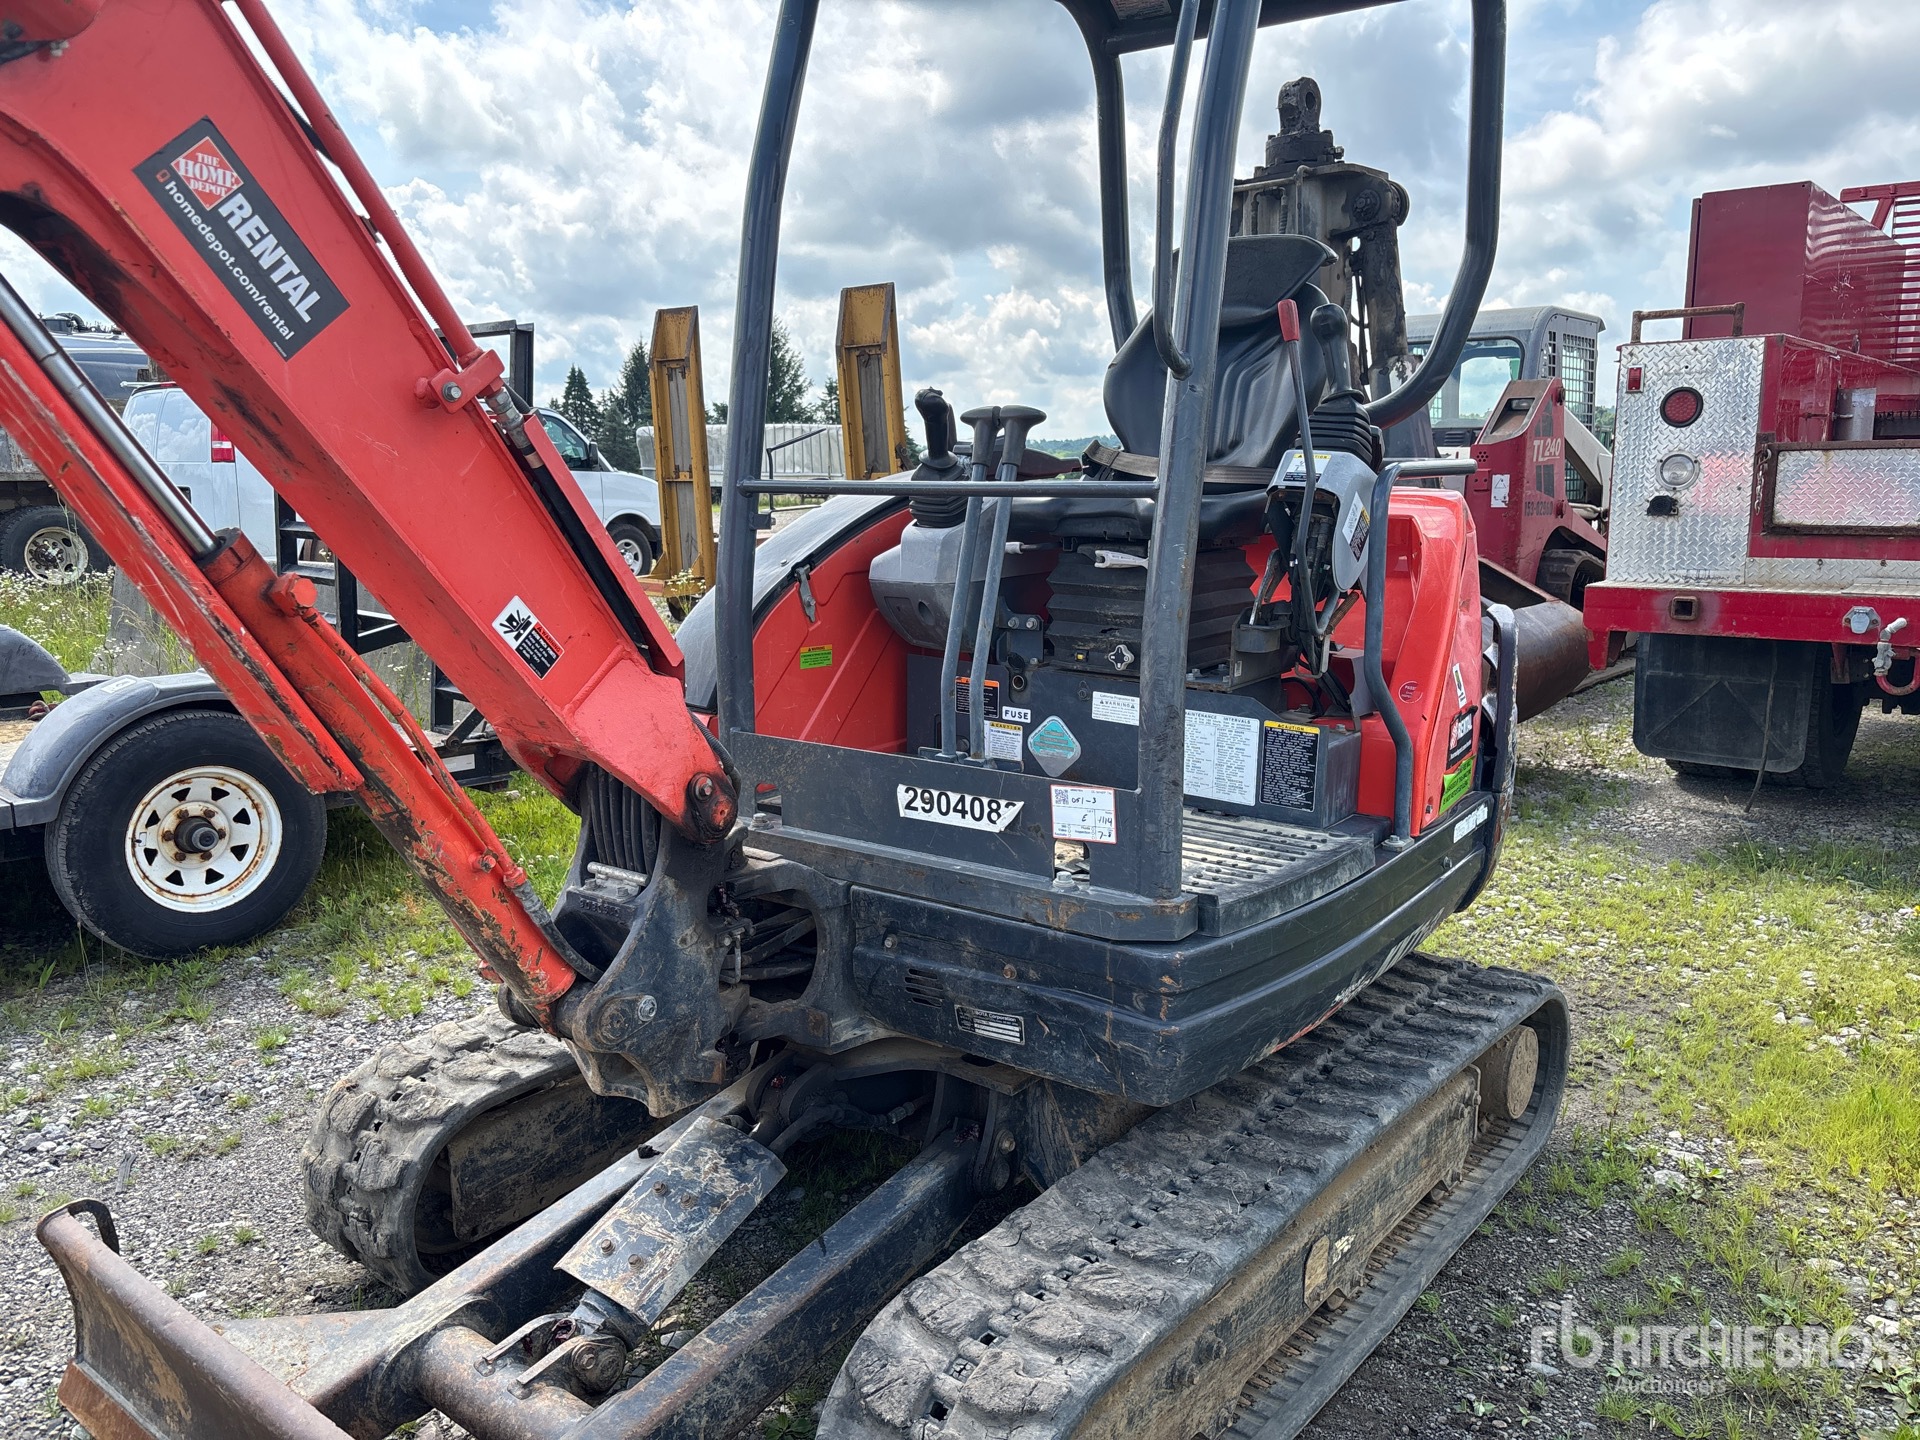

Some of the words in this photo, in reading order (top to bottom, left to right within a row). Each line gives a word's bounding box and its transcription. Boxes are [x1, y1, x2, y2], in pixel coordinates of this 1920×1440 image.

[196, 152, 220, 167] THE
[178, 158, 238, 189] HOME
[190, 178, 228, 197] DEPOT
[165, 181, 295, 340] homedepot.com/rental
[218, 193, 320, 323] RENTAL
[542, 631, 560, 652] WARNING
[1004, 709, 1029, 720] FUSE
[1223, 715, 1251, 724] INTERVALS
